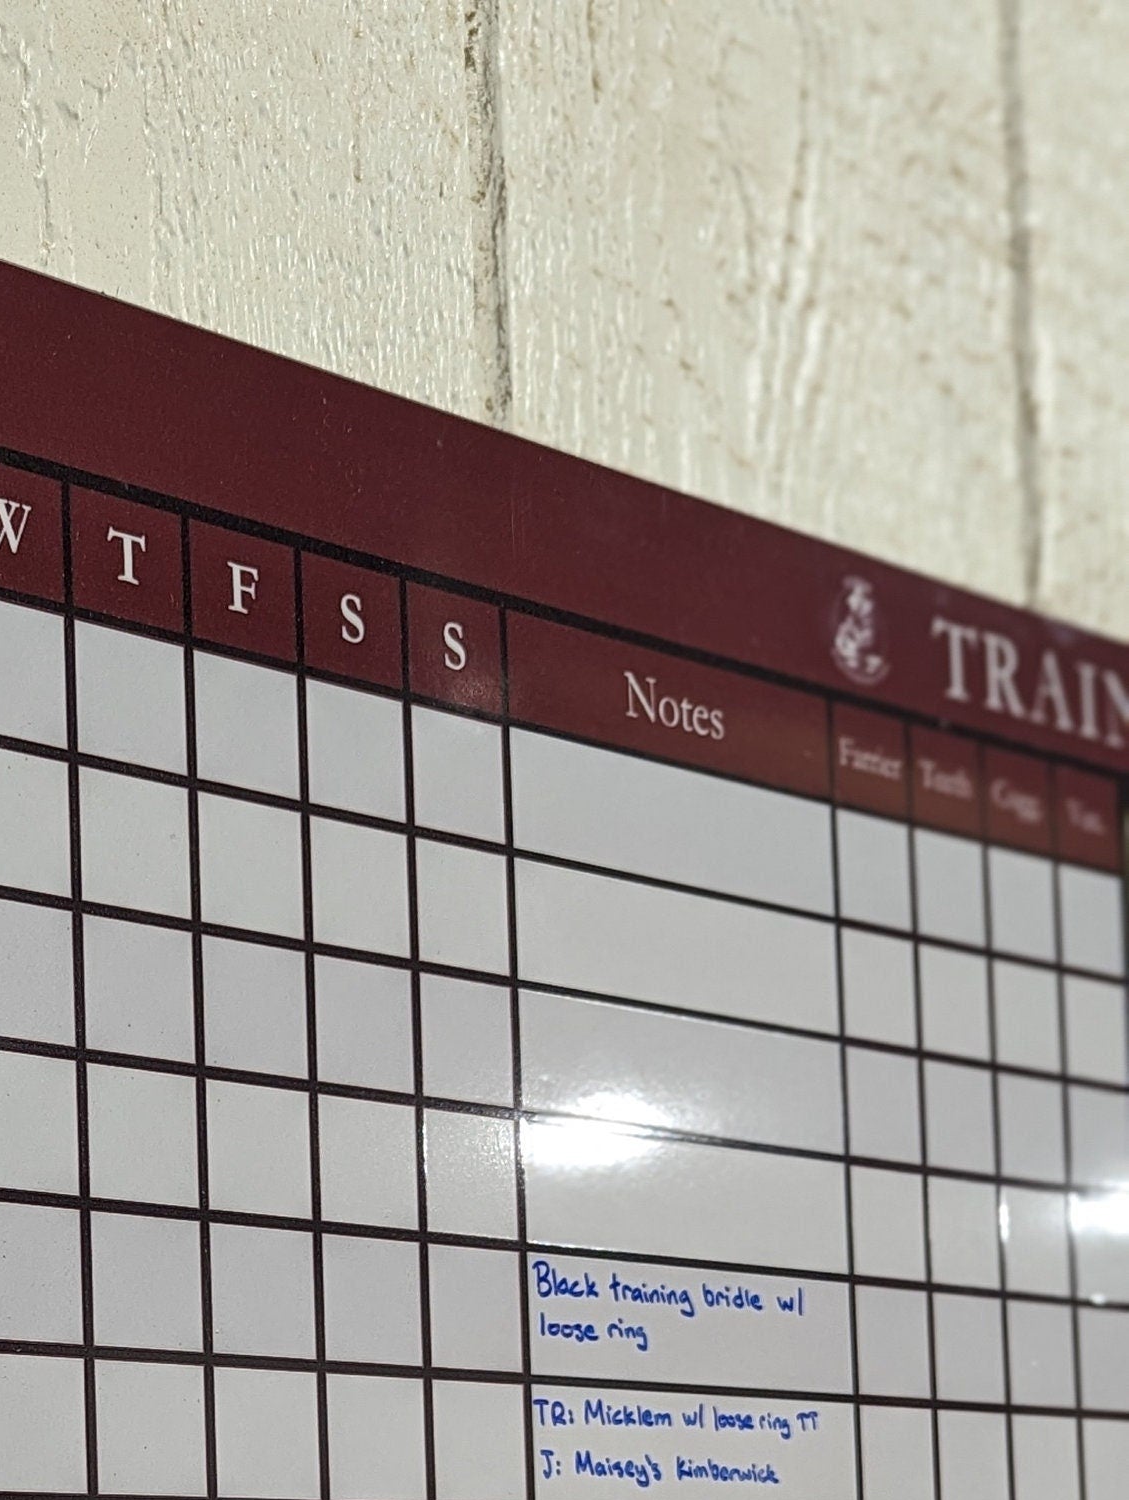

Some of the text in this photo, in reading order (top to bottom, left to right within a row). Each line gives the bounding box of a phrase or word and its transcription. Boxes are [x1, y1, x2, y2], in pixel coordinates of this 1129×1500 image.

[106, 525, 147, 585] T
[227, 560, 260, 614] F
[341, 593, 367, 644] S
[443, 621, 469, 671] S
[623, 671, 726, 740] Notes
[532, 1260, 803, 1317] Black training bridle w/
[540, 1313, 648, 1351] loose ring
[584, 1399, 672, 1427] Micklem
[682, 1404, 704, 1427] w/
[713, 1407, 755, 1431] loose
[758, 1414, 791, 1440] ring
[540, 1449, 561, 1480] J:
[575, 1451, 662, 1488] Maisey's
